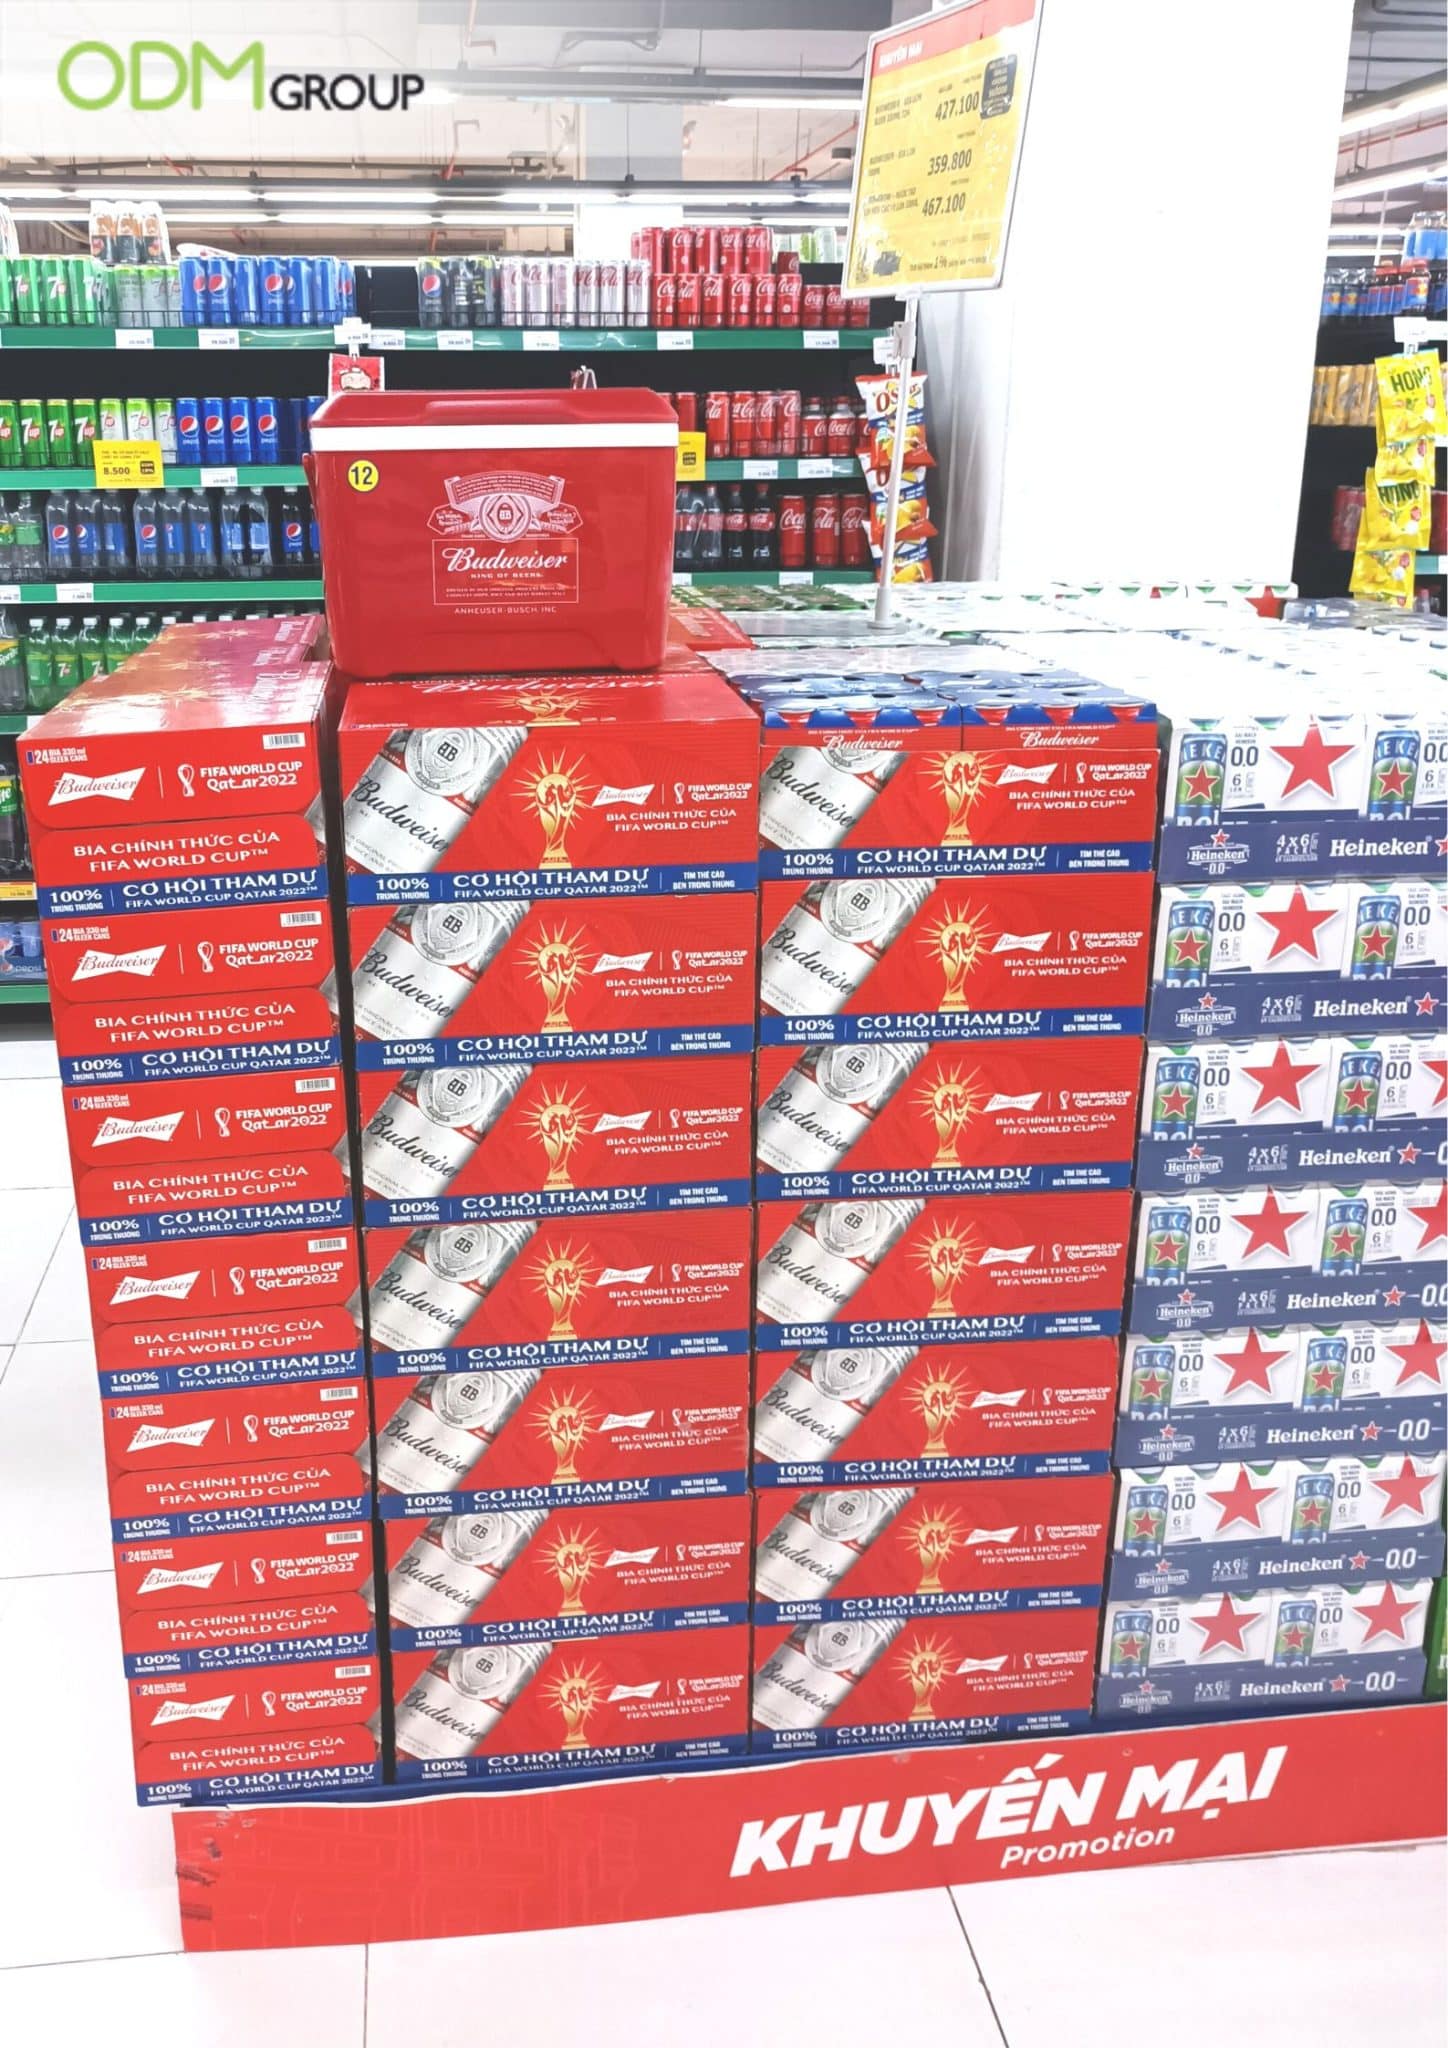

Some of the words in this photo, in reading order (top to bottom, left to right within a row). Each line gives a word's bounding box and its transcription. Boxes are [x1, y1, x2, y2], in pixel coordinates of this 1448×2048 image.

[935, 92, 980, 121] 427.100
[927, 150, 972, 176] 359.800
[921, 192, 966, 217] 467.100
[351, 466, 373, 486] 12
[442, 547, 568, 572] Budweiser
[541, 605, 557, 613] INC
[413, 676, 665, 694] Budweiser
[823, 735, 903, 750] Budweiser
[1021, 731, 1100, 748] Budweiser
[34, 750, 49, 764] 24
[1231, 746, 1258, 767] 0.0
[199, 765, 229, 777] FIFA
[229, 763, 275, 775] WORLD
[276, 760, 303, 772] CUP
[53, 774, 137, 796] Budweiser
[1017, 802, 1040, 810] FIFA
[1048, 801, 1087, 809] WORLD
[629, 810, 669, 820] CHÍNH
[615, 823, 639, 831] FIFA
[648, 822, 688, 830] WORLD
[73, 845, 103, 856] BIA
[110, 838, 174, 854] CHÍNH
[237, 827, 280, 845] CỦA
[1330, 839, 1429, 857] Heineken
[89, 859, 130, 872] FIFA
[133, 854, 204, 869] WORLD
[856, 849, 892, 863] CƠ
[898, 847, 938, 864] HỘI
[942, 847, 1006, 861] THAM
[1191, 849, 1246, 861] Heineken
[122, 881, 158, 897] CƠ
[164, 876, 206, 896] HỘI
[209, 872, 279, 890] THAM
[283, 869, 317, 885] DỰ
[375, 878, 428, 890] 100%
[452, 873, 489, 887] CƠ
[496, 870, 537, 888] HỘI
[542, 870, 607, 884] THAM
[614, 868, 648, 885] DỰ
[49, 888, 102, 903] 100%
[125, 899, 151, 908] FIFA
[154, 895, 200, 906] WORLD
[204, 892, 231, 902] CUP
[235, 889, 277, 900] QATAR
[454, 889, 483, 898] FIFA
[485, 888, 531, 897] WORLD
[534, 887, 561, 895] CUP
[564, 885, 606, 894] QATAR
[1218, 912, 1245, 932] 0.0
[77, 951, 158, 971] Budweiser
[1315, 997, 1409, 1018] Heineken
[1180, 1011, 1232, 1023] Heineken
[1204, 1068, 1230, 1087] 0.0
[97, 1117, 176, 1137] Budweiser
[1299, 1150, 1392, 1167] Heineken
[116, 1276, 192, 1295] Budweiser
[1287, 1292, 1376, 1309] Heineken
[550, 1340, 610, 1354] THAM
[396, 1352, 445, 1364] 100%
[132, 1424, 206, 1444] Budweiser
[1267, 1428, 1354, 1444] Heineken
[1398, 1419, 1430, 1441] 0.0
[777, 1465, 823, 1475] 100%
[1259, 1557, 1344, 1575] Heineken
[1385, 1548, 1416, 1569] 0.0
[143, 1567, 215, 1585] Budweiser
[917, 1593, 973, 1605] THAM
[157, 1621, 182, 1630] BIA
[1240, 1681, 1324, 1698] Heineken
[1365, 1672, 1396, 1691] 0.0
[422, 1760, 467, 1772] 100%
[729, 1753, 1107, 1878] KHUYẾN
[1115, 1745, 1289, 1821] MẠI
[1000, 1826, 1175, 1869] Promotion
